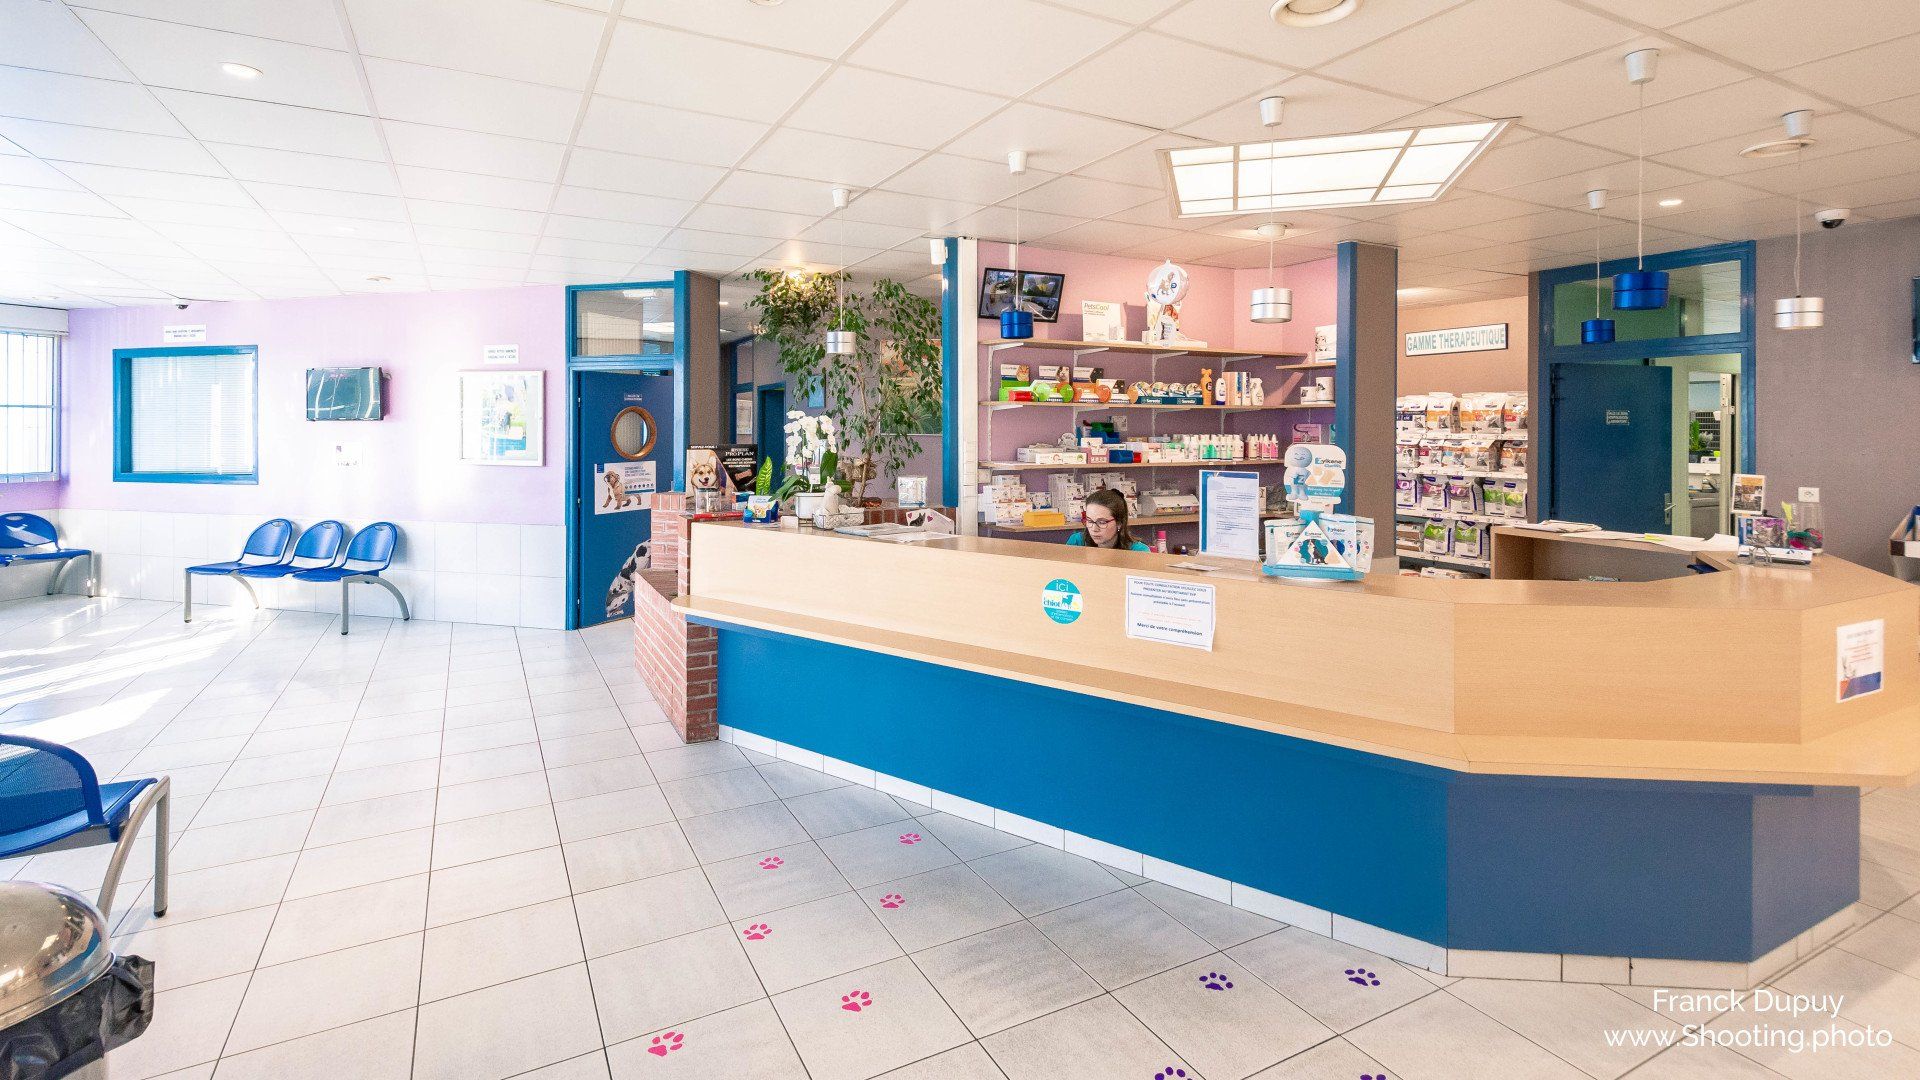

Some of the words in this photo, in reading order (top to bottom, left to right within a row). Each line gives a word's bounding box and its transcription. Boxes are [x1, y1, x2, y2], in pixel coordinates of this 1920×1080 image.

[1407, 335, 1437, 351] GAMME
[1439, 327, 1505, 349] THERAPEUTIQUE
[1168, 628, 1203, 636] compréhension
